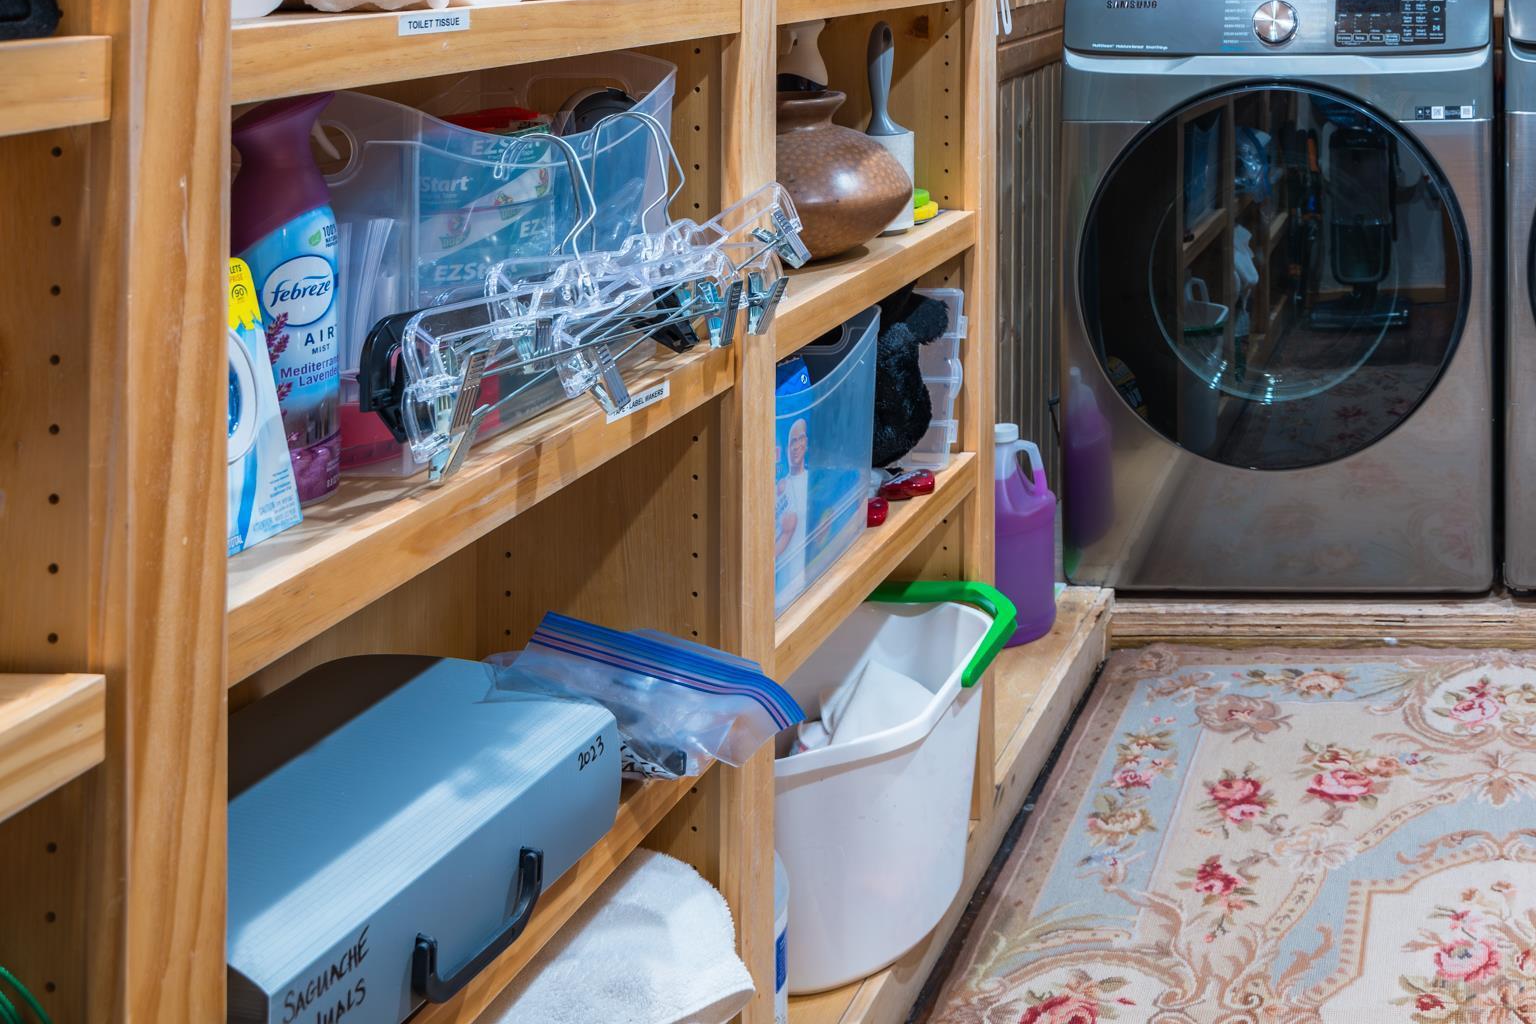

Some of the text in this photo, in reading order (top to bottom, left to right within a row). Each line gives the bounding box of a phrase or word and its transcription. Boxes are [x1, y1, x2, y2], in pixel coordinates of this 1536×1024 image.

[1106, 0, 1158, 9] SAMSUNG
[408, 17, 460, 29] TOILET TISSUE
[235, 288, 244, 297] 90
[270, 276, 331, 307] febreze
[304, 326, 335, 347] AIR
[311, 344, 331, 355] MIST
[629, 397, 645, 410] LABEL
[644, 388, 664, 402] MAKERS
[577, 735, 604, 772] 2023
[282, 925, 370, 1023] SAGUACHE
